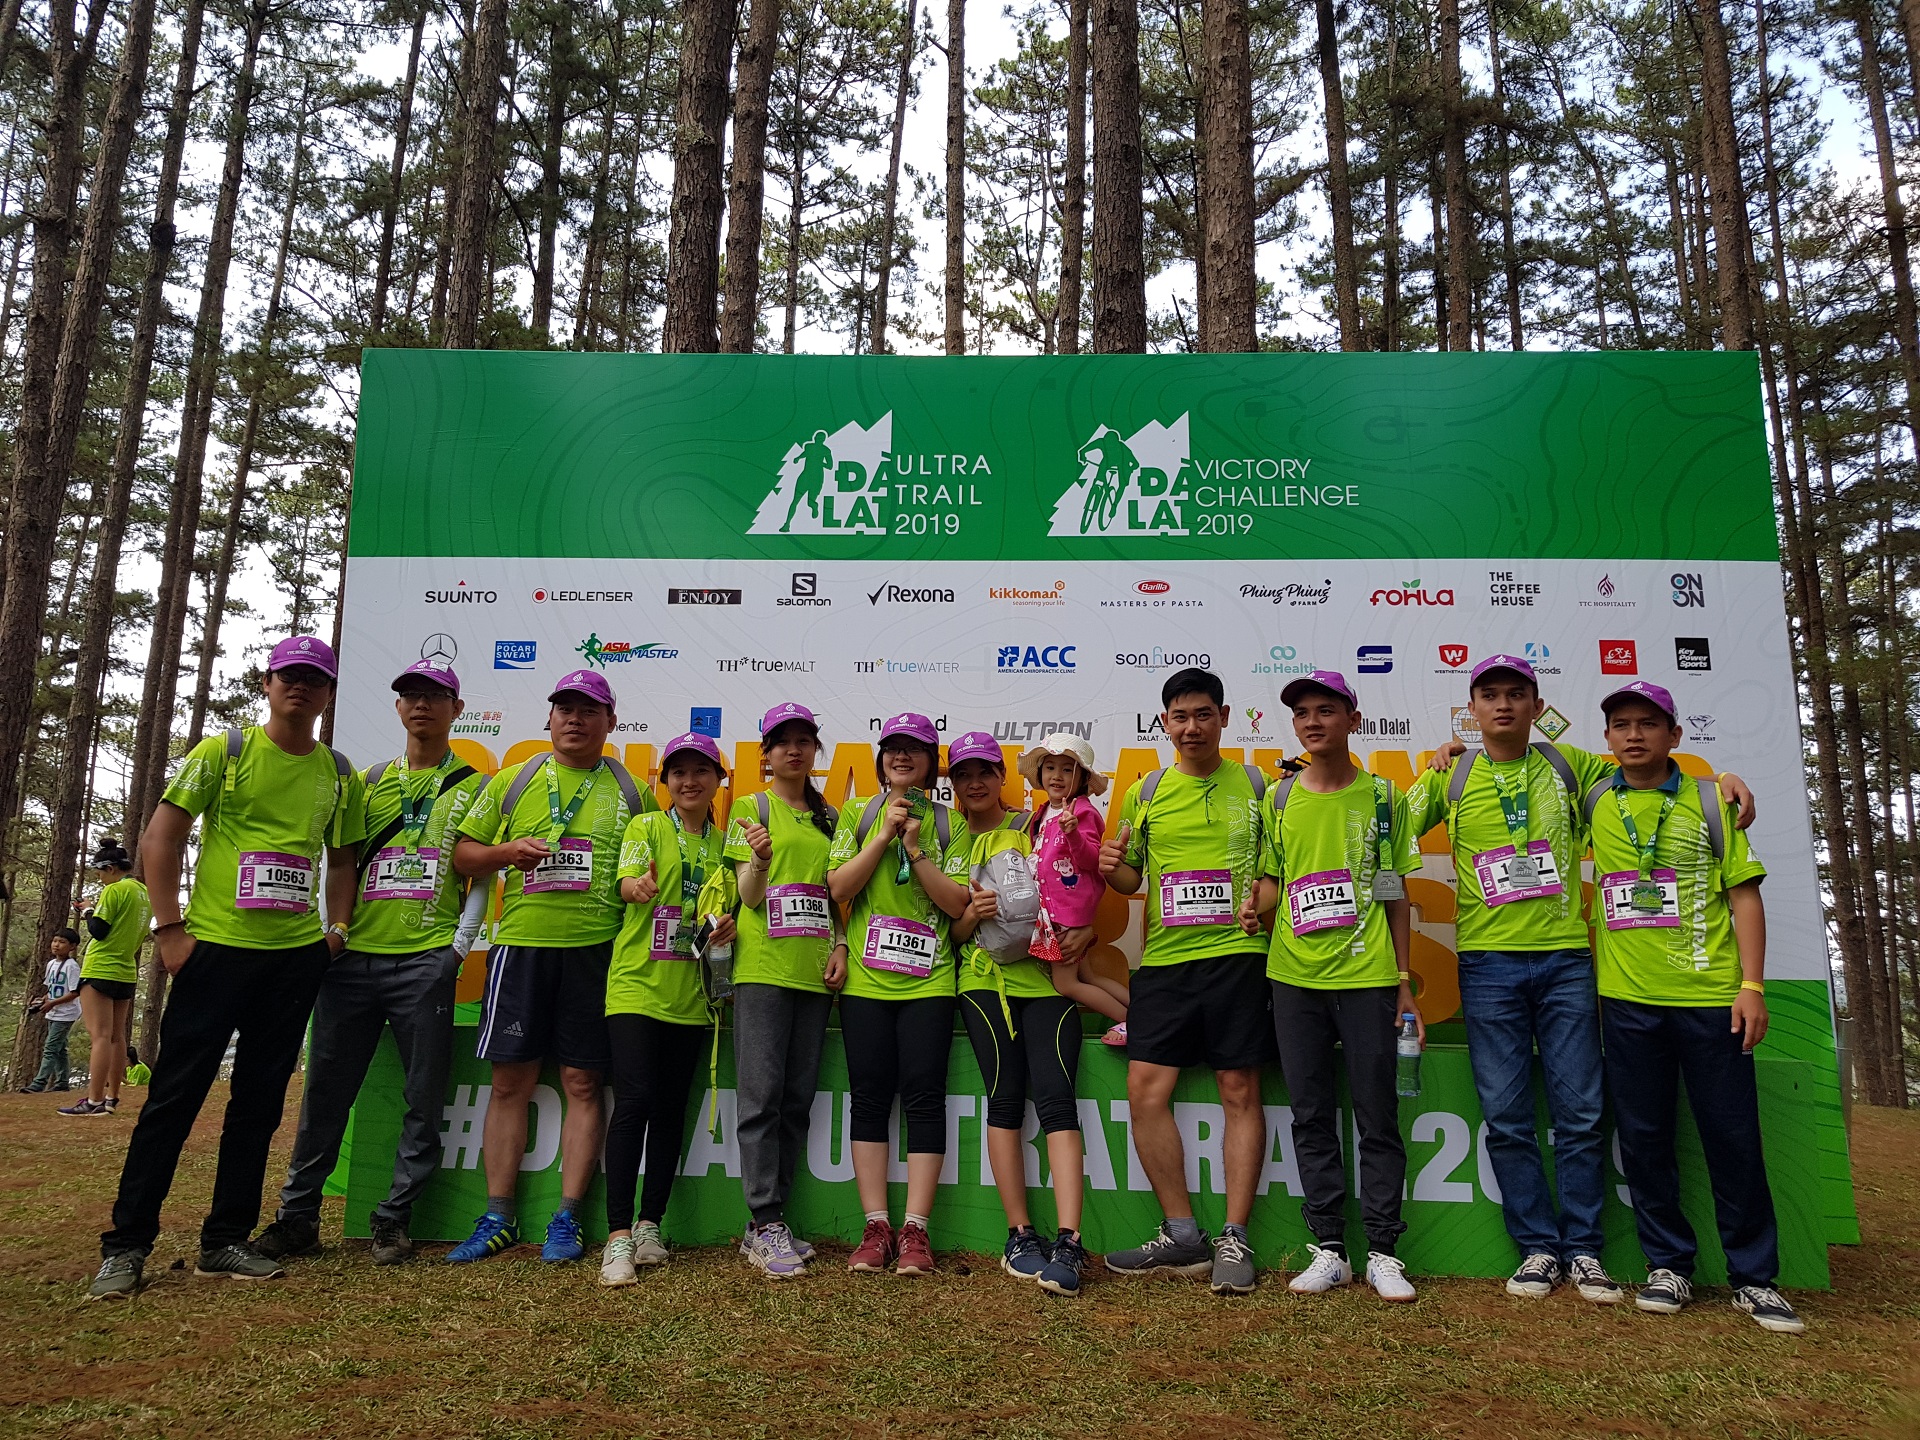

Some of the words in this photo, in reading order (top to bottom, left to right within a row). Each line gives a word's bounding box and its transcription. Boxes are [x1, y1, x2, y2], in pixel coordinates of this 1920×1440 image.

[896, 454, 992, 476] ULTRA
[1194, 458, 1312, 480] VICTORY
[895, 484, 983, 505] TRAIL
[1195, 485, 1360, 508] CHALLENGE
[895, 514, 960, 536] 2019
[1196, 514, 1254, 536] 2019
[1489, 571, 1513, 582] THE
[1670, 573, 1703, 590] ON
[887, 585, 955, 603] Rexona
[1140, 583, 1168, 592] Barilla
[1490, 584, 1541, 594] COFFEE
[424, 590, 498, 604] SUUNTO
[551, 591, 633, 602] LEDLENSER
[678, 592, 733, 604] ENJOY
[1491, 596, 1534, 606] HOUSE
[603, 642, 631, 652] ASIA
[1678, 648, 1695, 656] Key
[598, 653, 632, 663] TRAIL
[629, 649, 679, 659] MASTER
[1022, 646, 1077, 668] ACC
[716, 660, 739, 672] TH
[854, 661, 874, 673] TH
[1251, 663, 1271, 673] Jio
[1273, 663, 1317, 673] Health
[706, 716, 720, 726] T8
[1349, 718, 1376, 735] ello
[1379, 718, 1411, 735] Dalat
[450, 722, 501, 736] running
[566, 810, 574, 818] 10
[241, 867, 253, 897] 10km
[265, 867, 306, 885] 10563
[367, 863, 379, 889] 10km
[1480, 868, 1495, 895] 10km
[1182, 885, 1224, 899] 11370
[1303, 885, 1345, 904] 11374
[1523, 888, 1543, 897] Rexona
[790, 898, 824, 913] 11368
[1163, 889, 1174, 917] 10km
[1605, 890, 1614, 919] 10km
[769, 899, 781, 926] 10km
[1291, 898, 1303, 926] 10km
[1197, 916, 1215, 924] Rexona
[1320, 917, 1339, 926] Rexona
[1636, 918, 1657, 926] Rexona
[654, 921, 666, 948] 10km
[887, 931, 926, 951] 11361
[866, 930, 880, 956] 10km
[894, 962, 912, 973] Rexona
